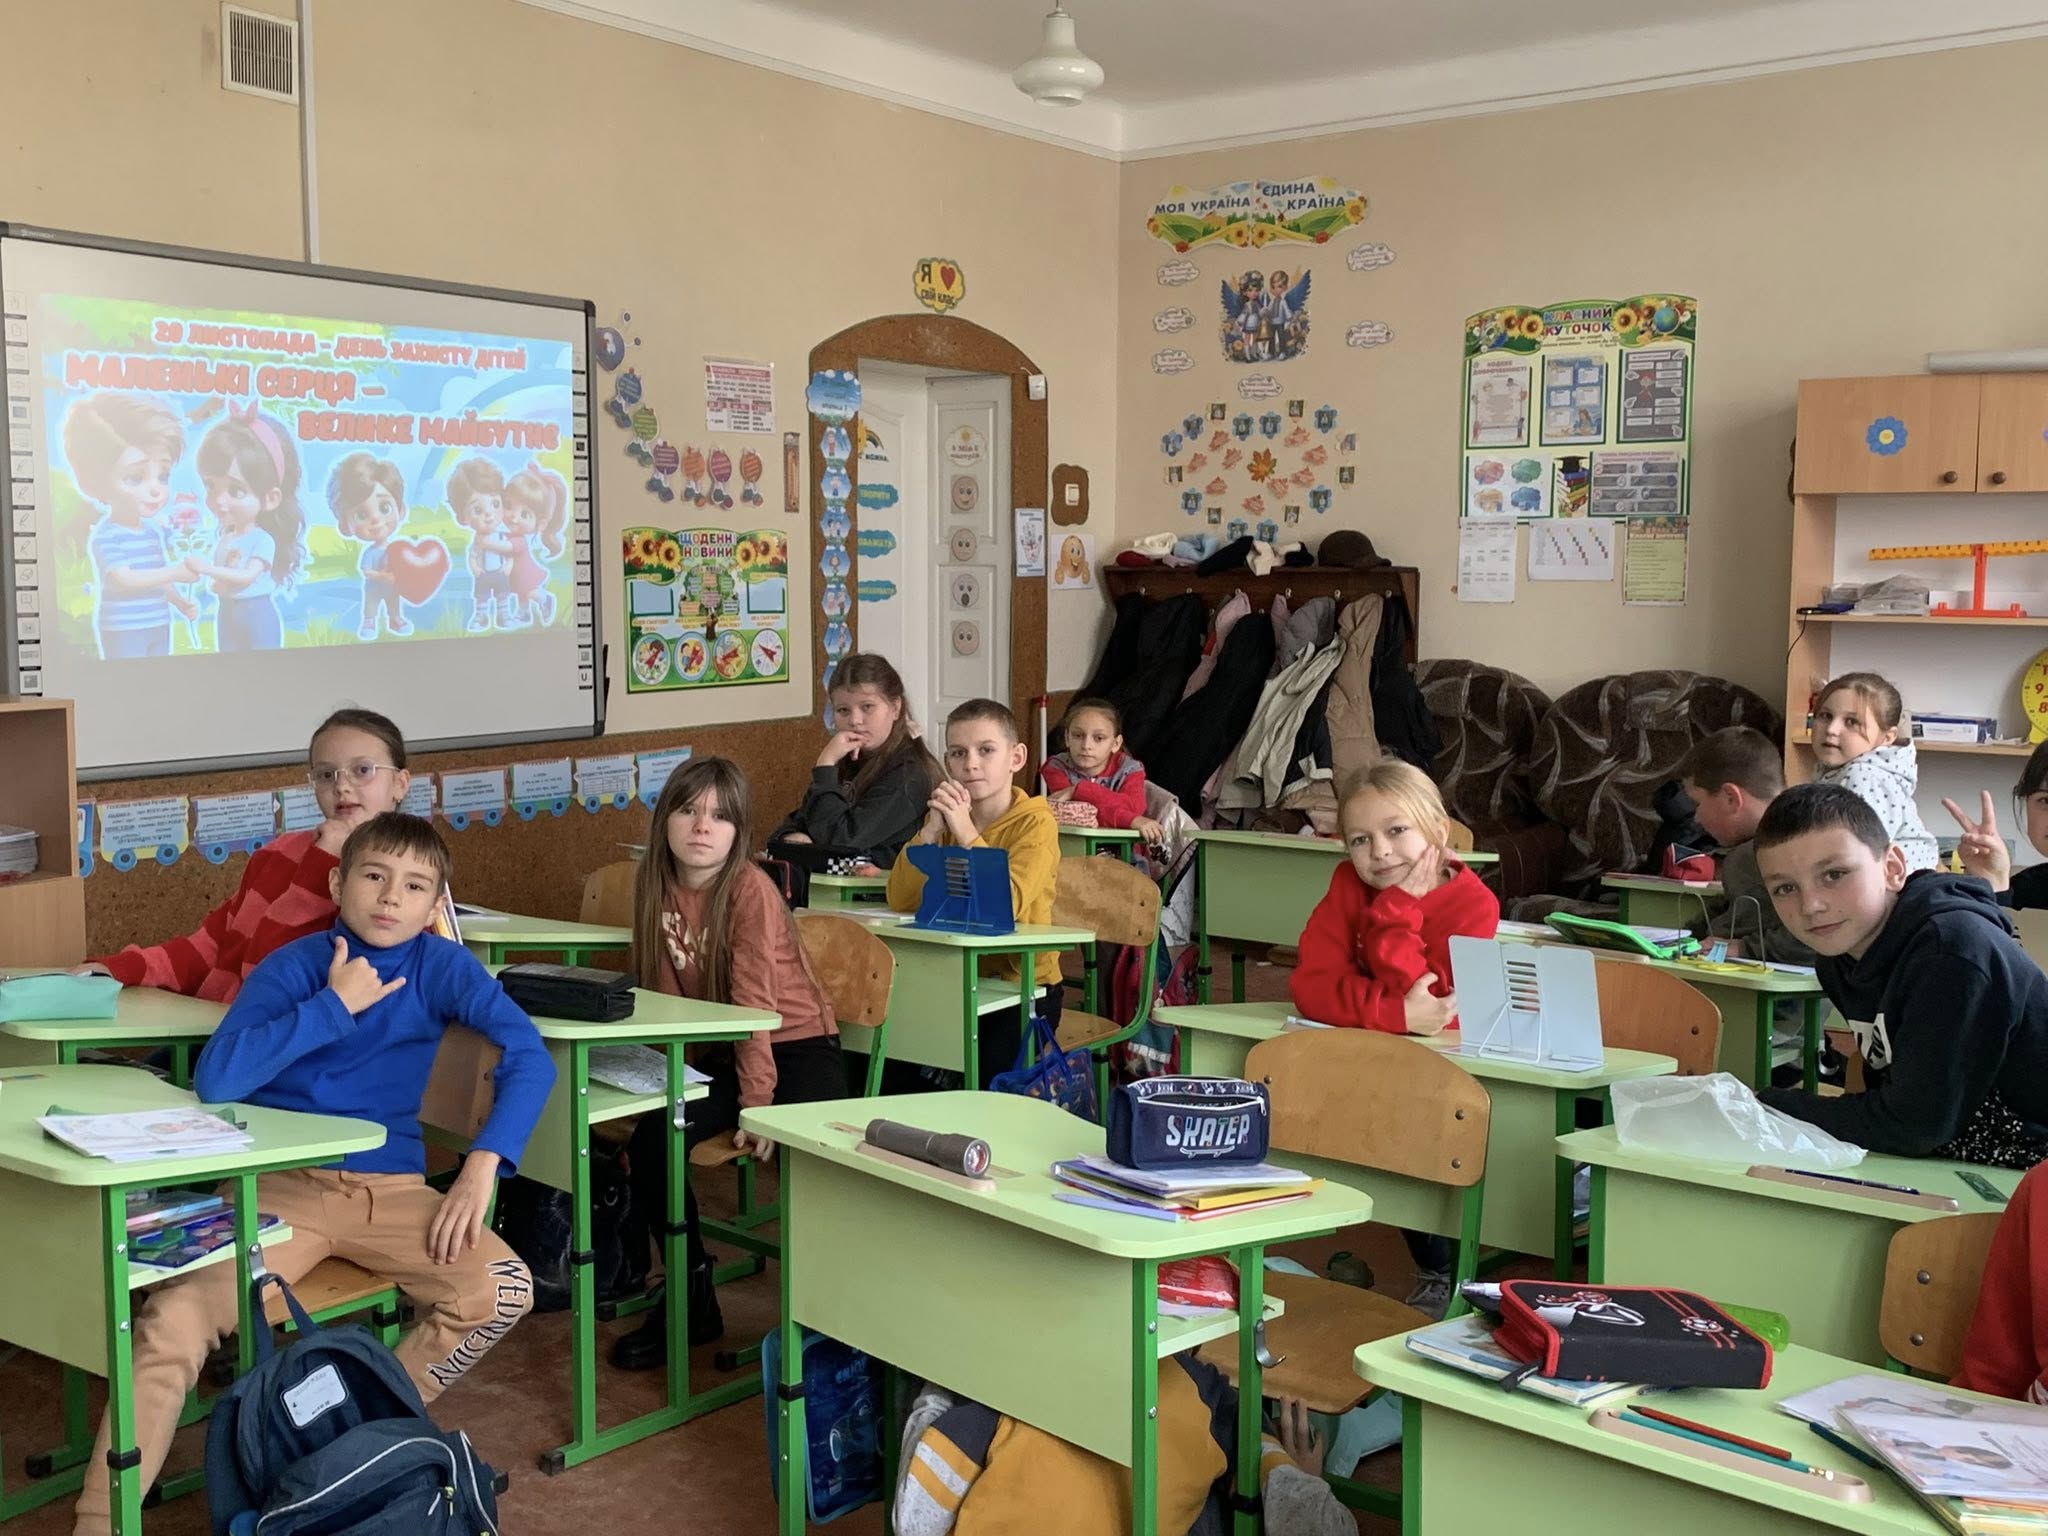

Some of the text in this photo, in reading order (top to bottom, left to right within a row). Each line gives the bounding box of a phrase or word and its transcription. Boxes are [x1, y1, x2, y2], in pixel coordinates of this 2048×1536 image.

[1262, 182, 1315, 197] ЄДИНА
[1154, 196, 1250, 215] МОЯ УКРАЇНА
[1287, 196, 1346, 210] КРАЇНА
[921, 263, 932, 284] Я
[1543, 304, 1612, 322] КЛАСНИЙ
[1544, 321, 1611, 336] КУТОЧОК
[154, 320, 183, 344] 20
[188, 323, 316, 356] ЛИСТОПАДА
[334, 335, 387, 359] ДЕНЬ
[390, 341, 473, 366] ЗАХИСТУ
[474, 346, 526, 370] ДІТЕЙ
[66, 352, 250, 396] МАЛЕНЬКІ
[256, 366, 356, 406] СЕРЦЯ
[297, 410, 415, 444] ВЕЛИКЕ
[680, 532, 737, 546] ЩОДЕННІ
[684, 546, 733, 558] НОВИНИ
[2035, 682, 2045, 694] 9
[2038, 702, 2048, 714] 8
[1165, 1113, 1250, 1147] SKATER
